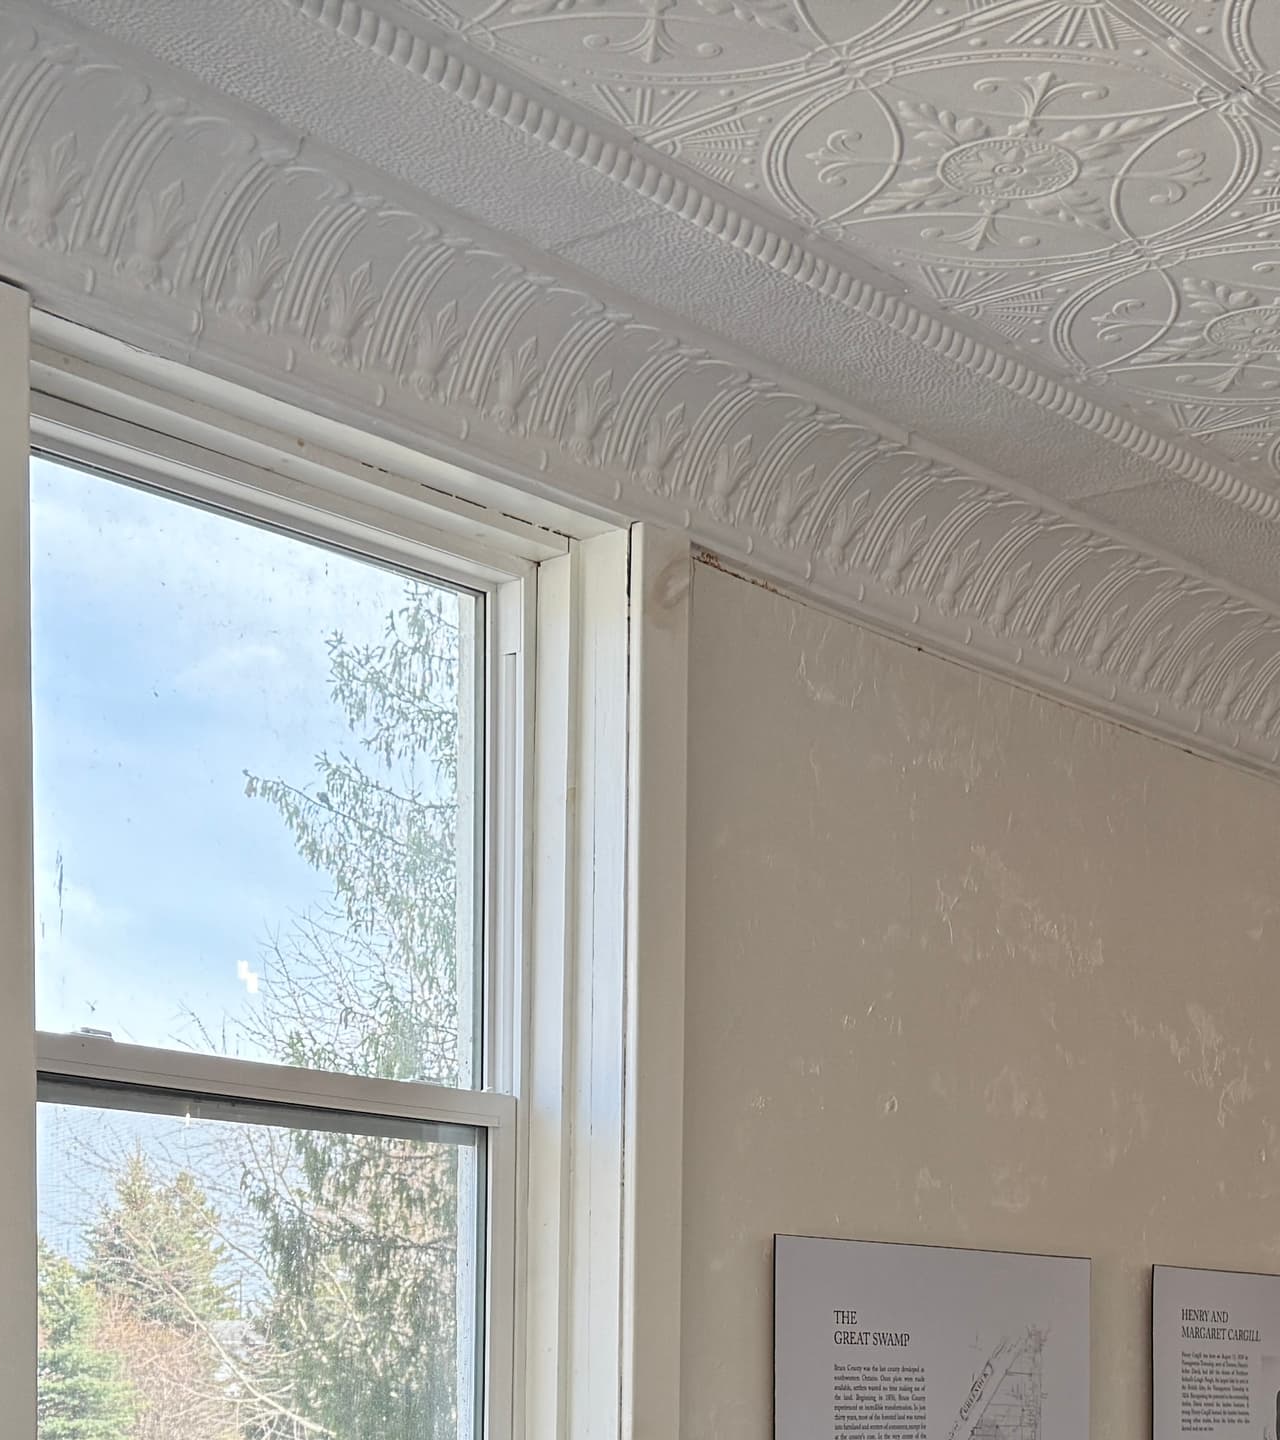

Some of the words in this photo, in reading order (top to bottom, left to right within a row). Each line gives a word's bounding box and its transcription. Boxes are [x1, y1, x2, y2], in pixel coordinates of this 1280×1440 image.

[834, 1310, 857, 1325] THE
[1181, 1309, 1210, 1323] HENRY
[1212, 1311, 1229, 1324] AND
[834, 1331, 870, 1346] GREAT
[872, 1333, 910, 1347] SWAMP
[1181, 1326, 1227, 1341] MARGARET
[1228, 1328, 1261, 1342] CARGILL
